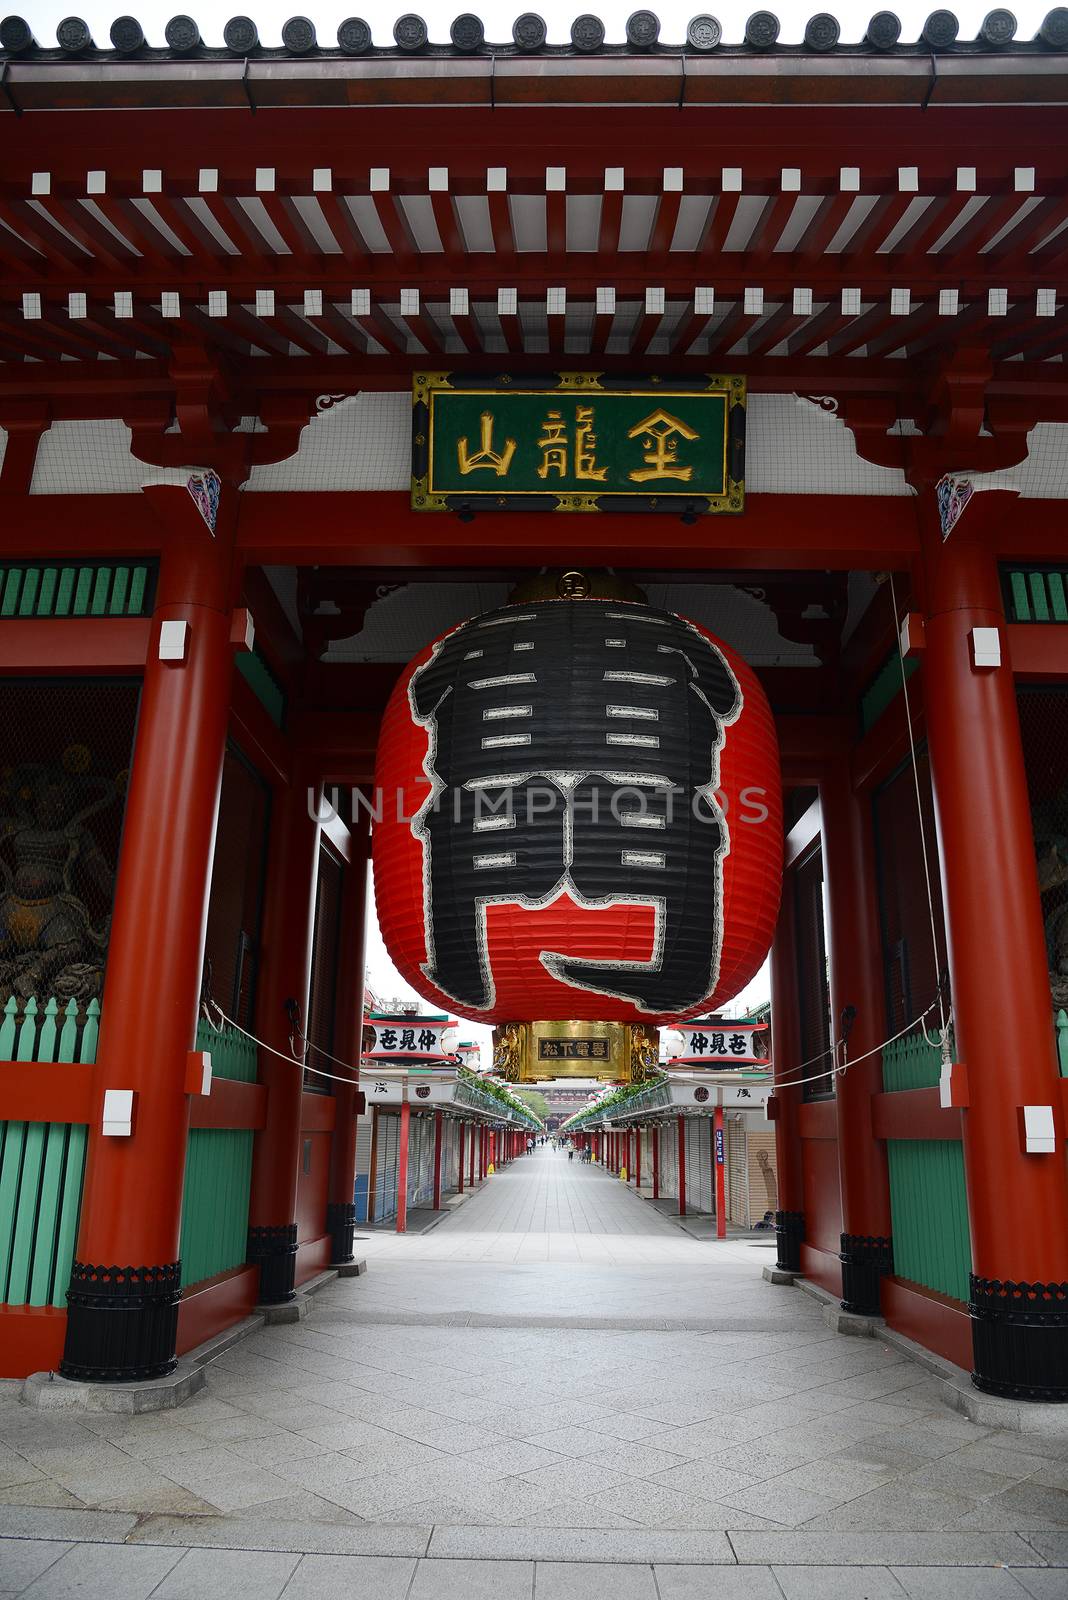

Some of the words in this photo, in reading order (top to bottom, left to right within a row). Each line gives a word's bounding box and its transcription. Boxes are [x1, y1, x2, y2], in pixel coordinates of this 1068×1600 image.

[457, 404, 700, 482] 金龍山
[543, 1042, 605, 1057] 松下電器
